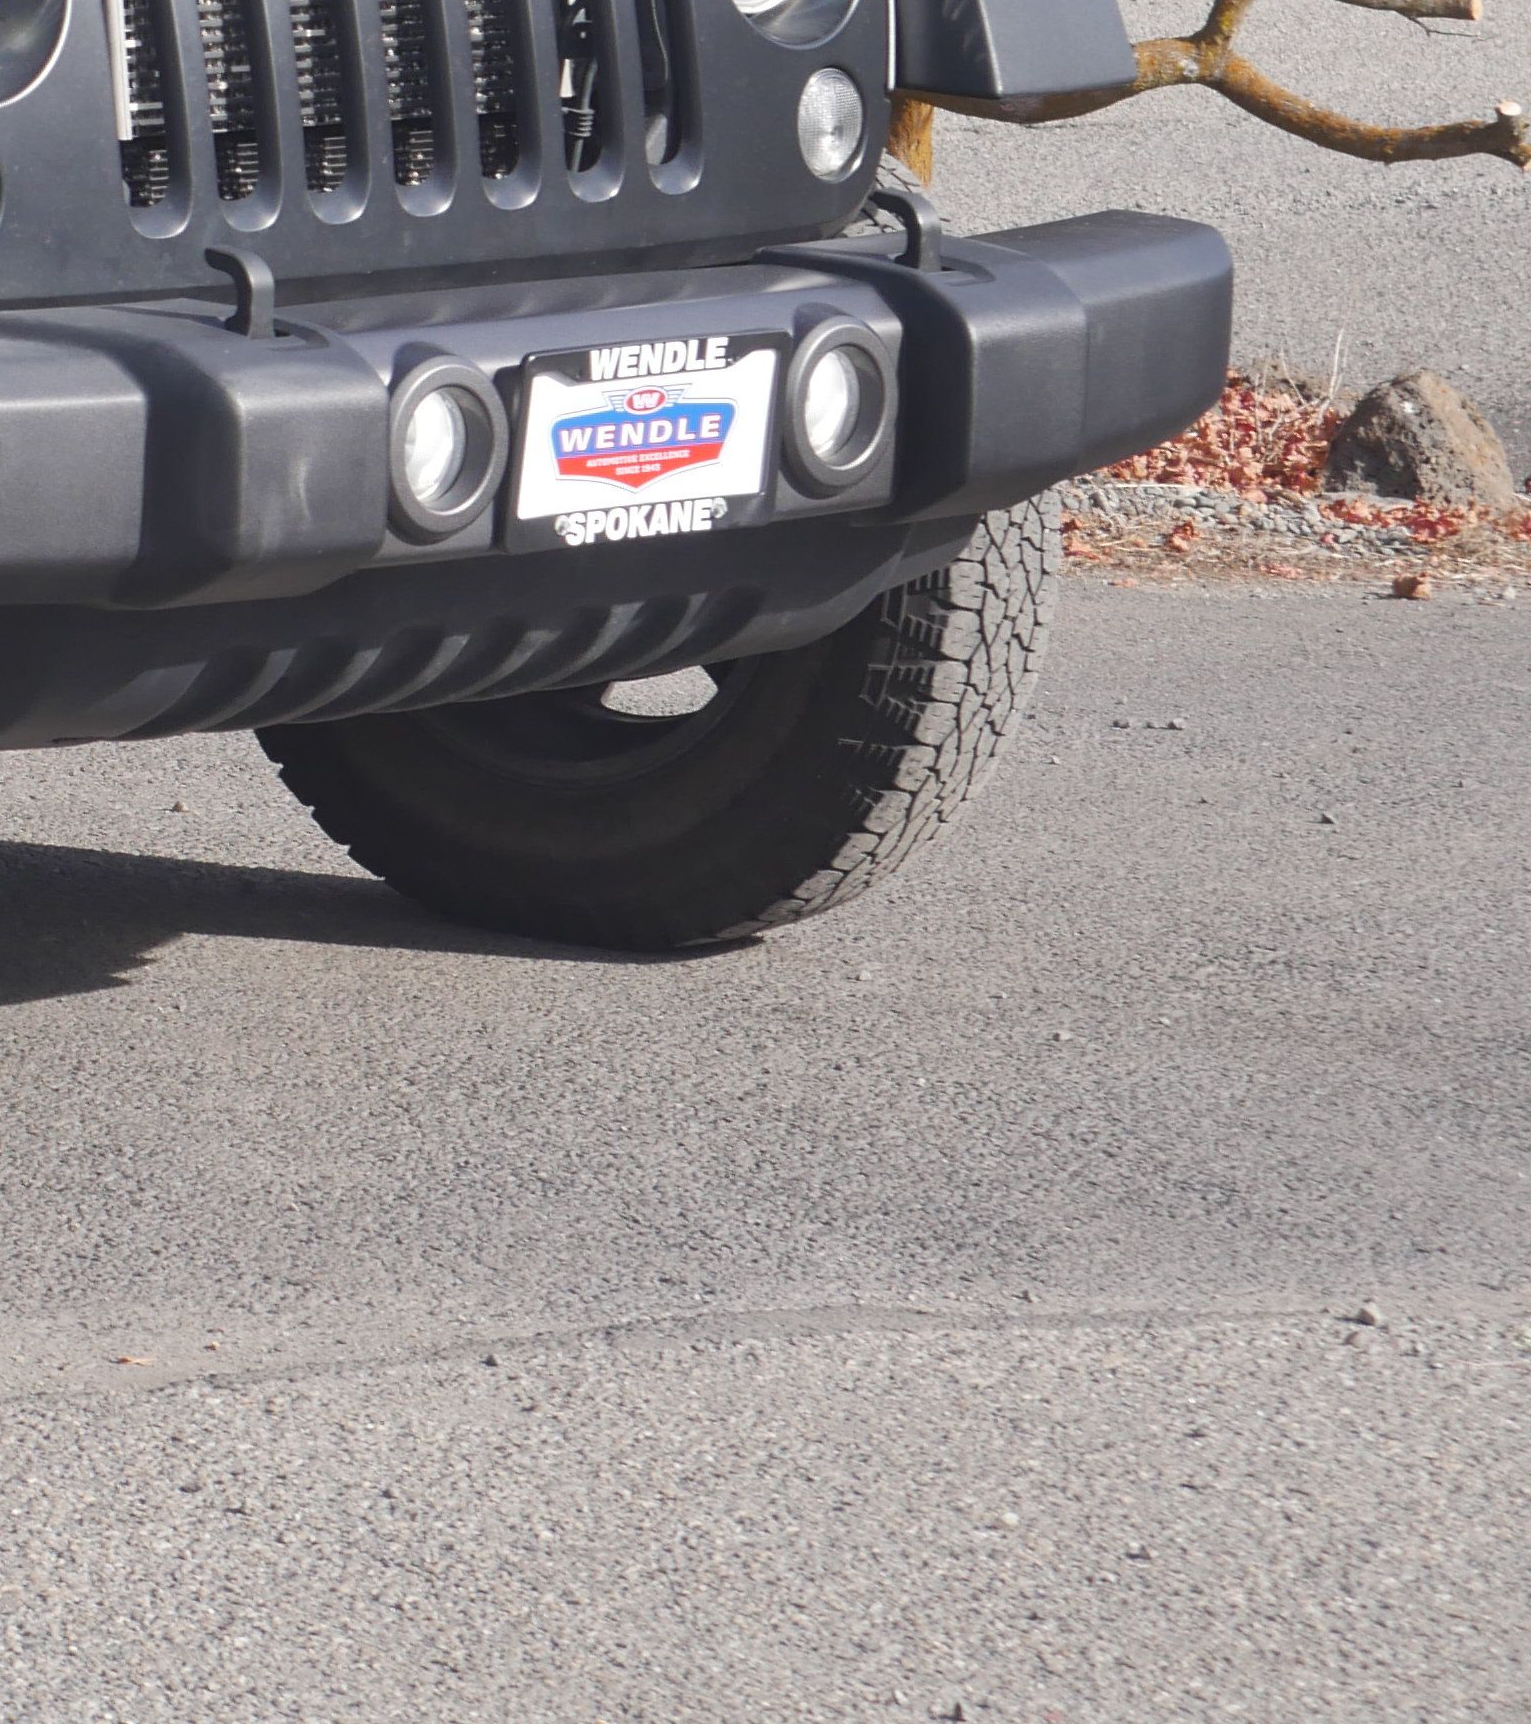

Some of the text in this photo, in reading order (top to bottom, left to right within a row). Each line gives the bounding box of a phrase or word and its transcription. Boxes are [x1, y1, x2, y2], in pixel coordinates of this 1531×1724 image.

[589, 337, 730, 382] WENDLE
[560, 414, 722, 453] WENDLE
[639, 450, 690, 462] EXCELLENCE
[565, 497, 713, 547] SPOKANE
